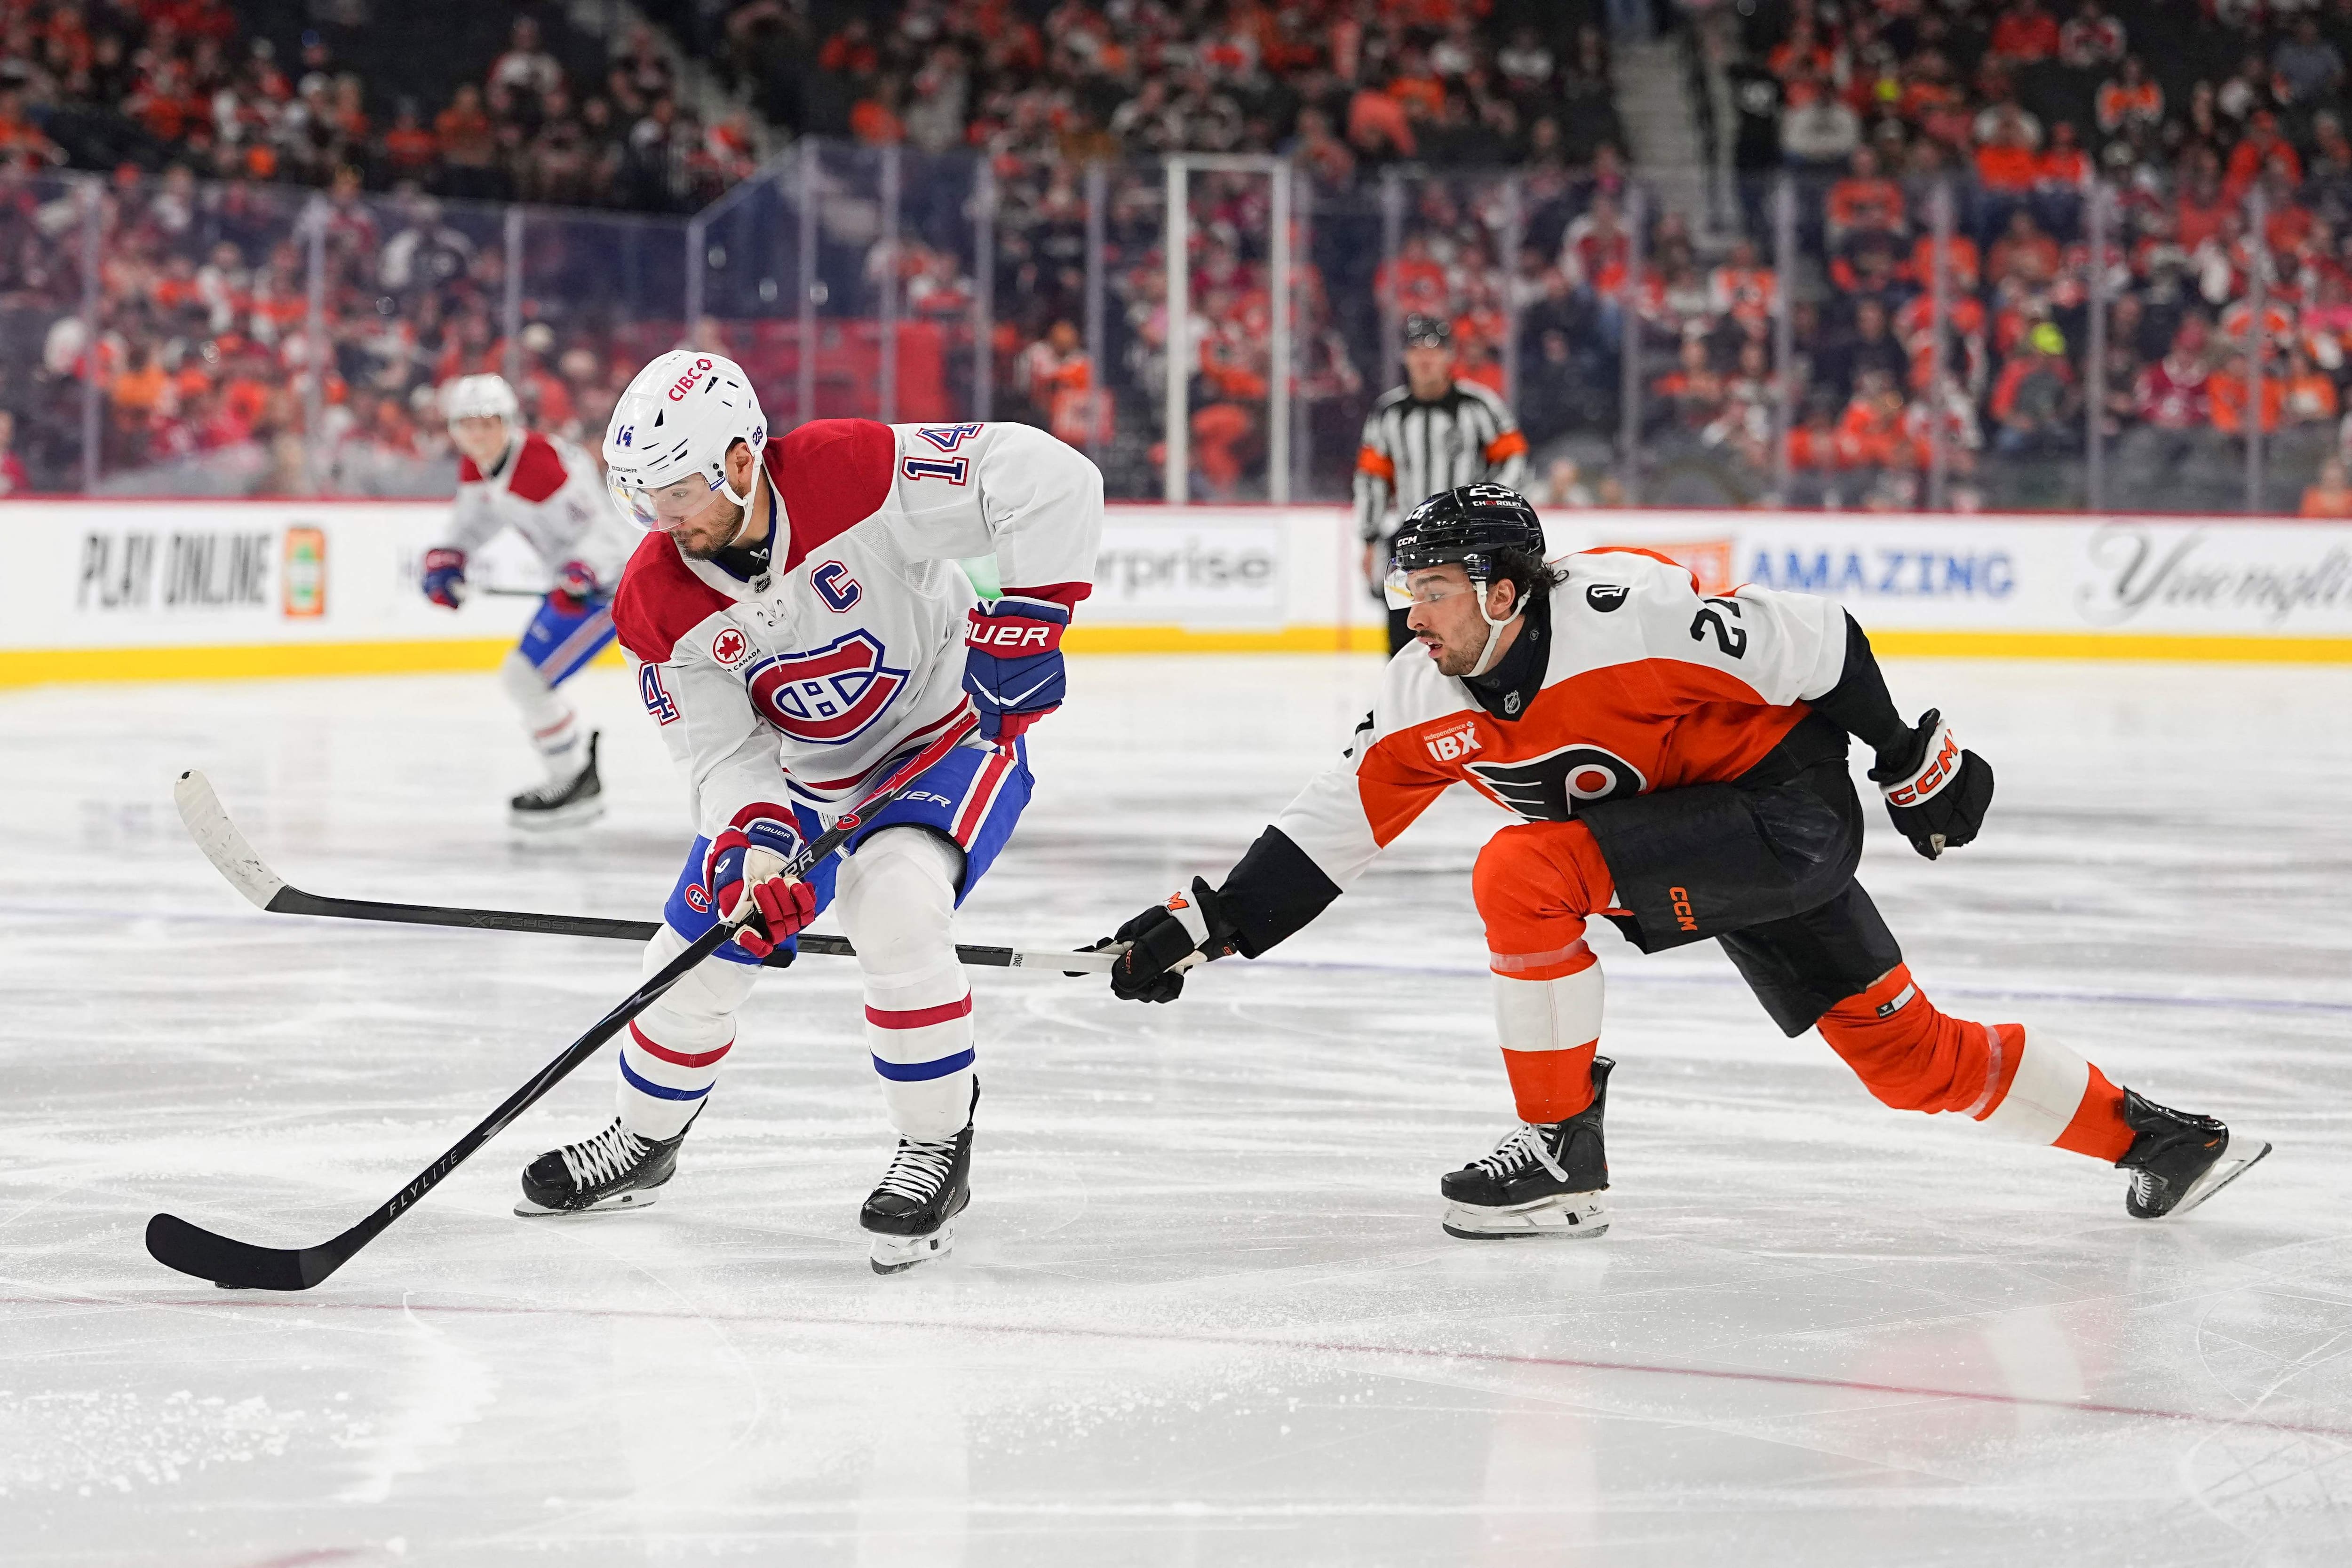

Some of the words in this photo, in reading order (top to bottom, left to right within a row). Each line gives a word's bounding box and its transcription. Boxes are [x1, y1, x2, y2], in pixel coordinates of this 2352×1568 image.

[668, 368, 702, 401] CIBC
[615, 425, 635, 447] 14
[753, 426, 763, 446] 29
[901, 424, 984, 486] 14
[1397, 535, 1417, 547] CCM
[77, 531, 154, 607] PLAY
[165, 531, 273, 606] ONLINE
[810, 560, 862, 613] C
[1093, 536, 1277, 599] rprise
[1749, 548, 2015, 599] AMAZING
[733, 647, 761, 672] CANADA
[639, 661, 681, 726] 4
[1423, 724, 1466, 742] Independence
[1426, 728, 1482, 762] IBX
[1889, 735, 1958, 806] CCM
[755, 824, 791, 839] BAUER
[1669, 887, 1698, 931] CCM
[389, 1149, 458, 1218] FLYLITE
[940, 1186, 956, 1215] BAUER
